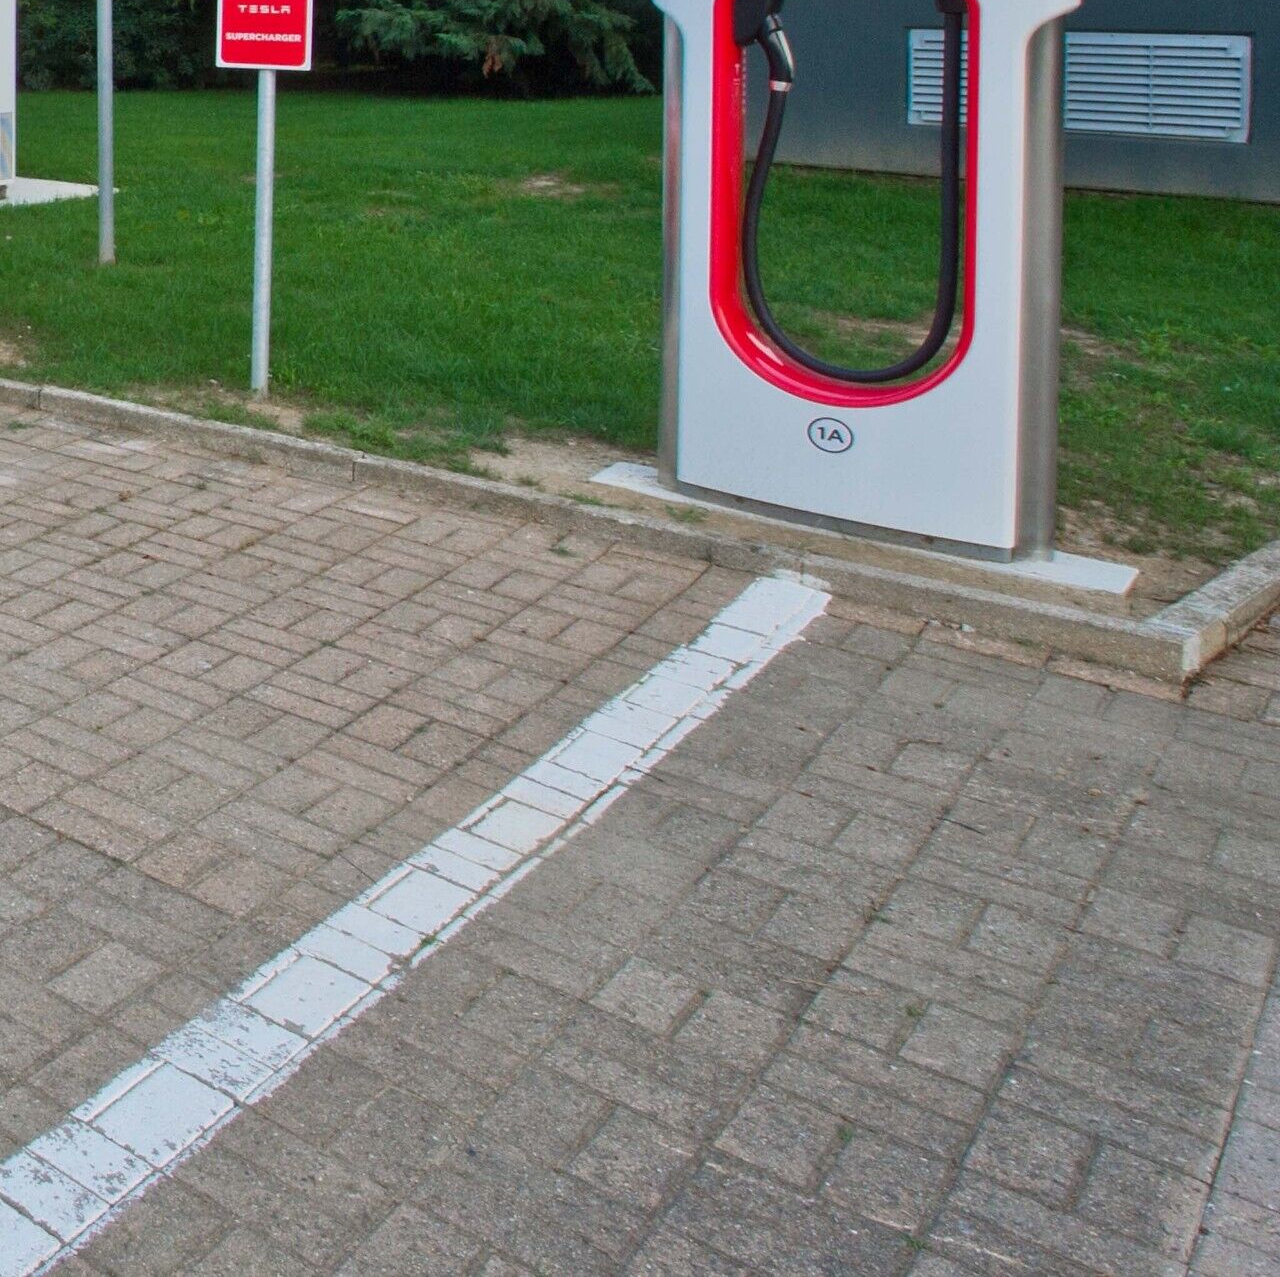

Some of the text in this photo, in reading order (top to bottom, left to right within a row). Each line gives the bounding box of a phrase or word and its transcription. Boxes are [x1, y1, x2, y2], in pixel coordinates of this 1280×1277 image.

[237, 4, 292, 15] TESLA
[225, 32, 302, 43] SUPERCHARGER
[817, 427, 845, 443] 1A
